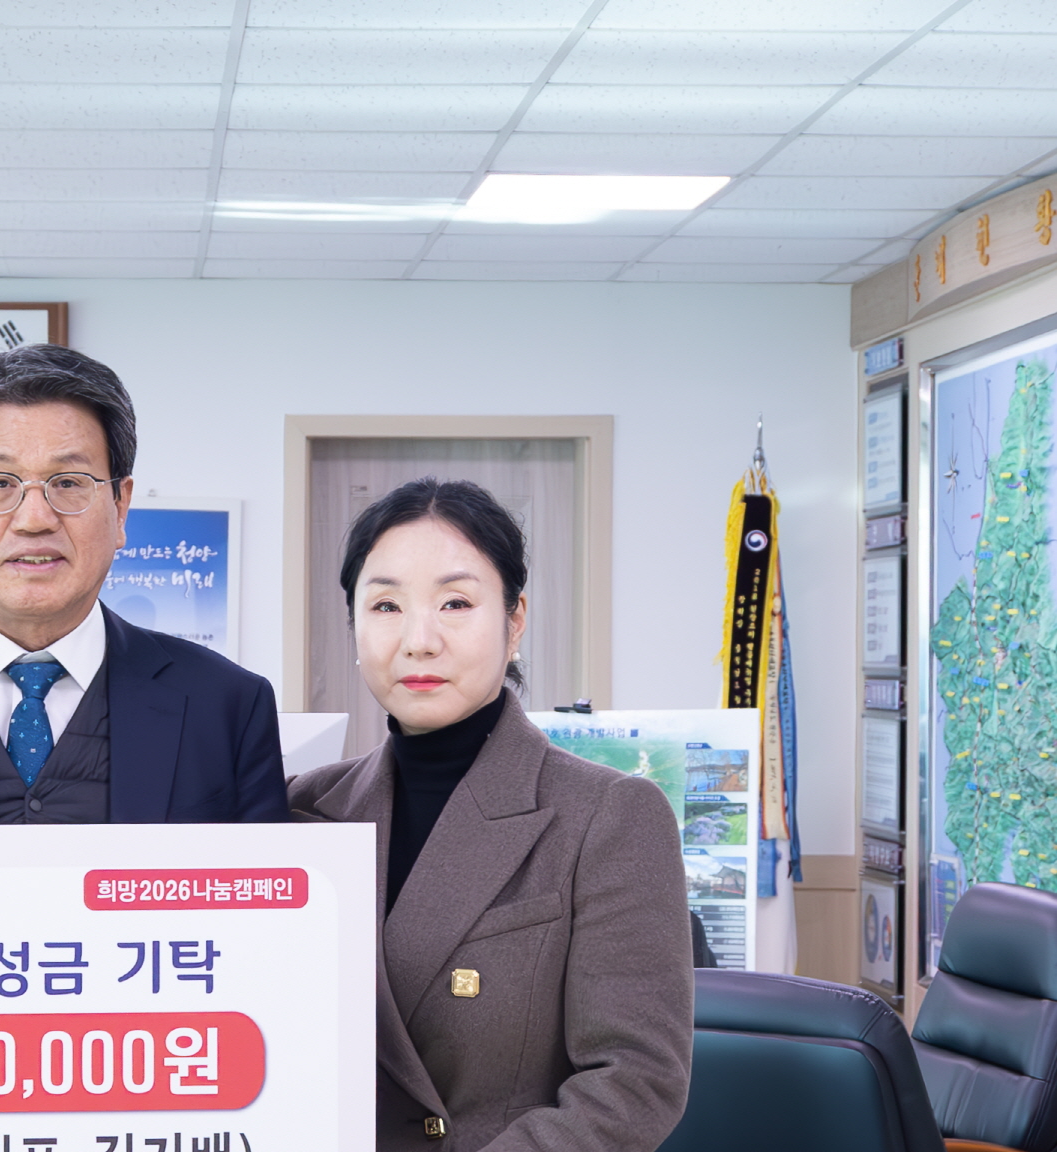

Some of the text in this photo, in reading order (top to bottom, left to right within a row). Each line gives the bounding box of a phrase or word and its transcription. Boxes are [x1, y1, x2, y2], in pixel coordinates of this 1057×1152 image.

[176, 540, 218, 565] 청양
[128, 572, 167, 590] 행복한
[171, 569, 215, 598] 미래
[96, 878, 292, 903] 희망2026나눔캠페인
[117, 940, 221, 994] 기탁
